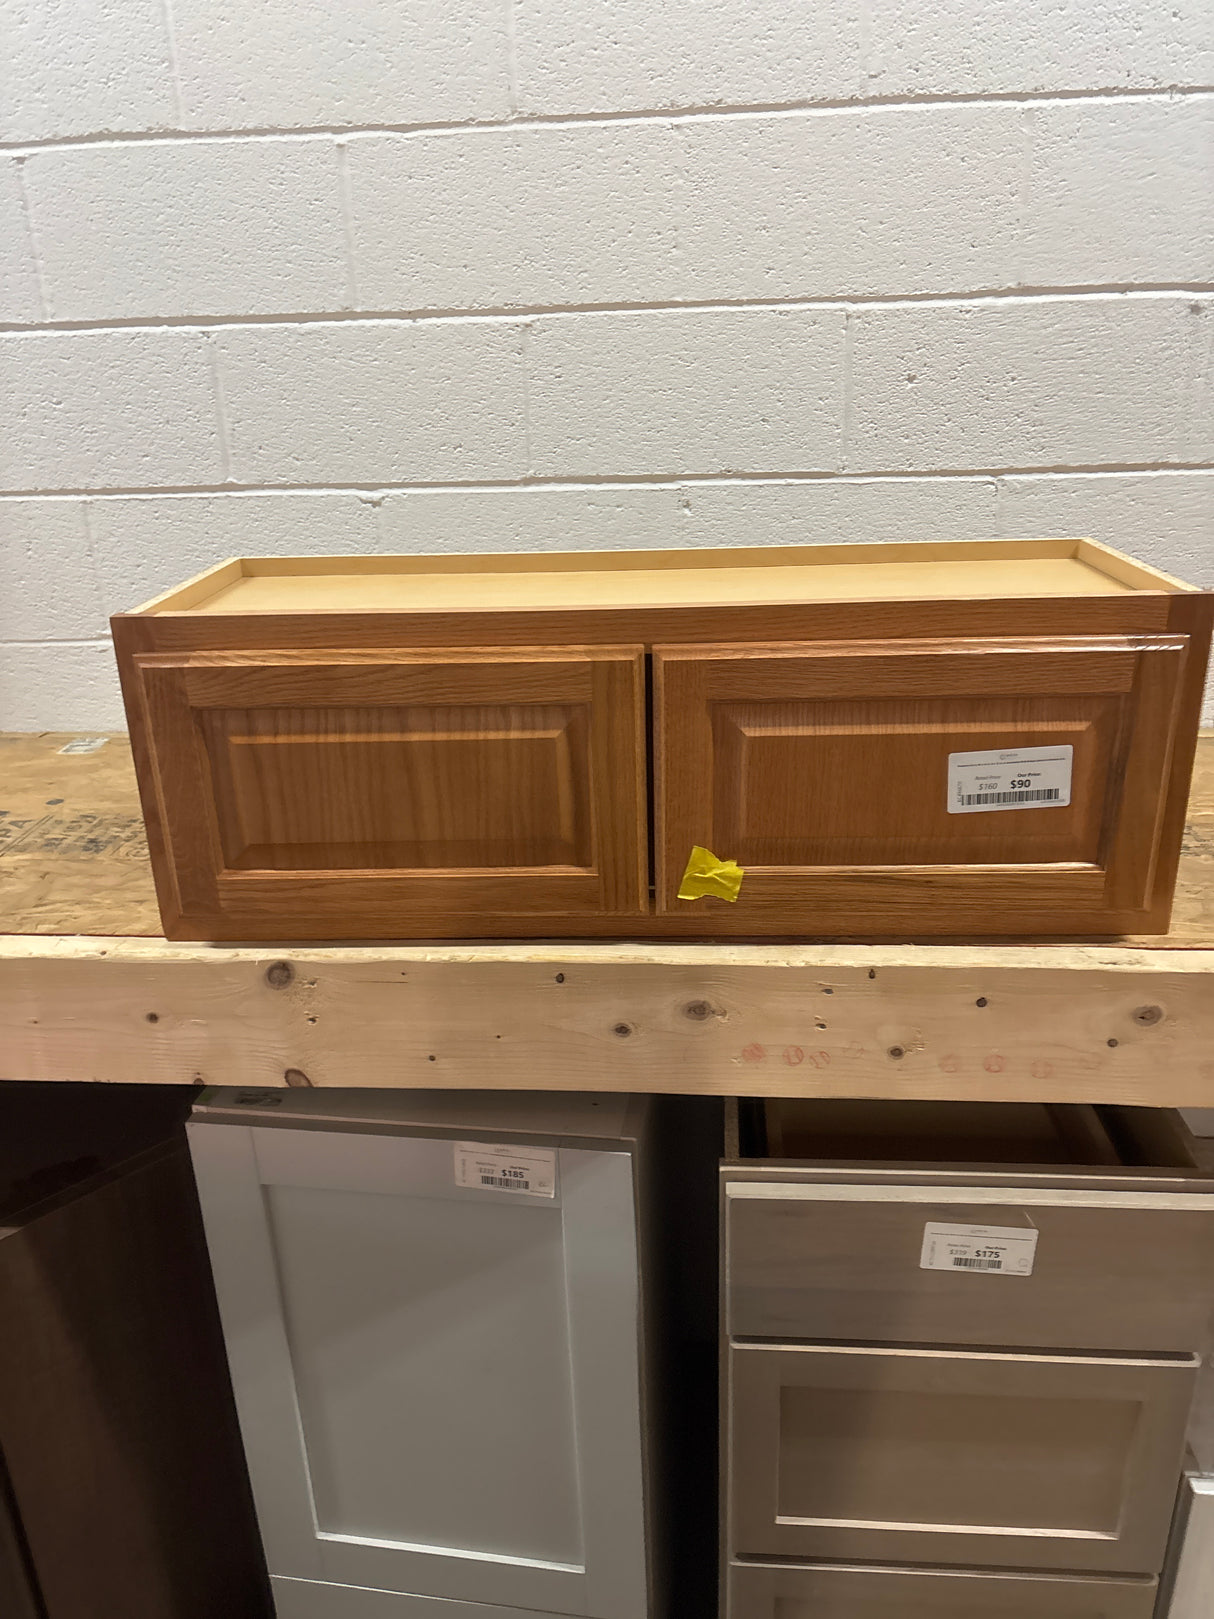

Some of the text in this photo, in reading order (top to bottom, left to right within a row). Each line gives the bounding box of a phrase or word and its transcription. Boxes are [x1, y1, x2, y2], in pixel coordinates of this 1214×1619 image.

[978, 783, 998, 791] $160
[1010, 779, 1031, 790] $90
[502, 1169, 524, 1179] $185
[975, 1249, 1000, 1259] $175
